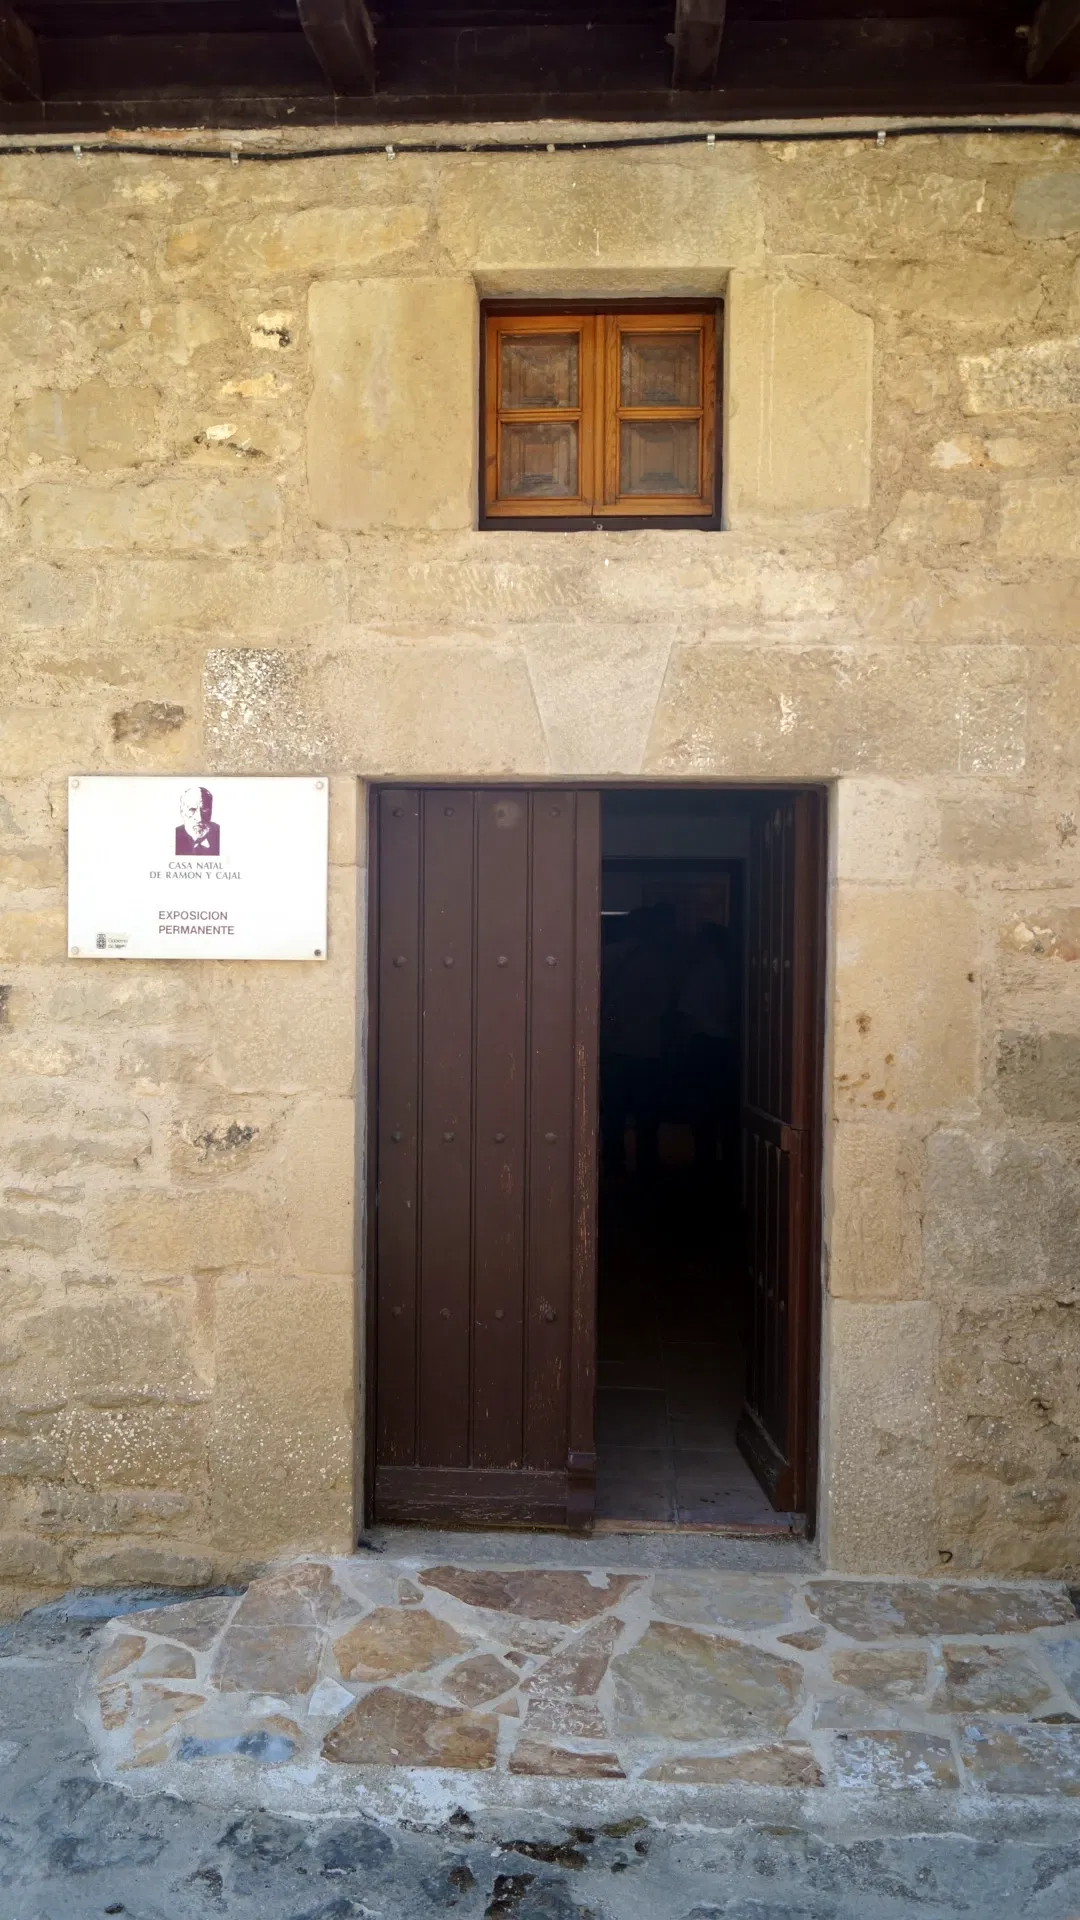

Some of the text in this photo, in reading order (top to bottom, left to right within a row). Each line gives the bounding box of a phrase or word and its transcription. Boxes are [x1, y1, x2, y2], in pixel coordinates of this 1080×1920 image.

[168, 861, 224, 869] CASA NATAL
[149, 871, 242, 880] DE RAMON Y CAJAL
[158, 910, 228, 920] EXPOSICION
[158, 925, 235, 935] PERMANENTE
